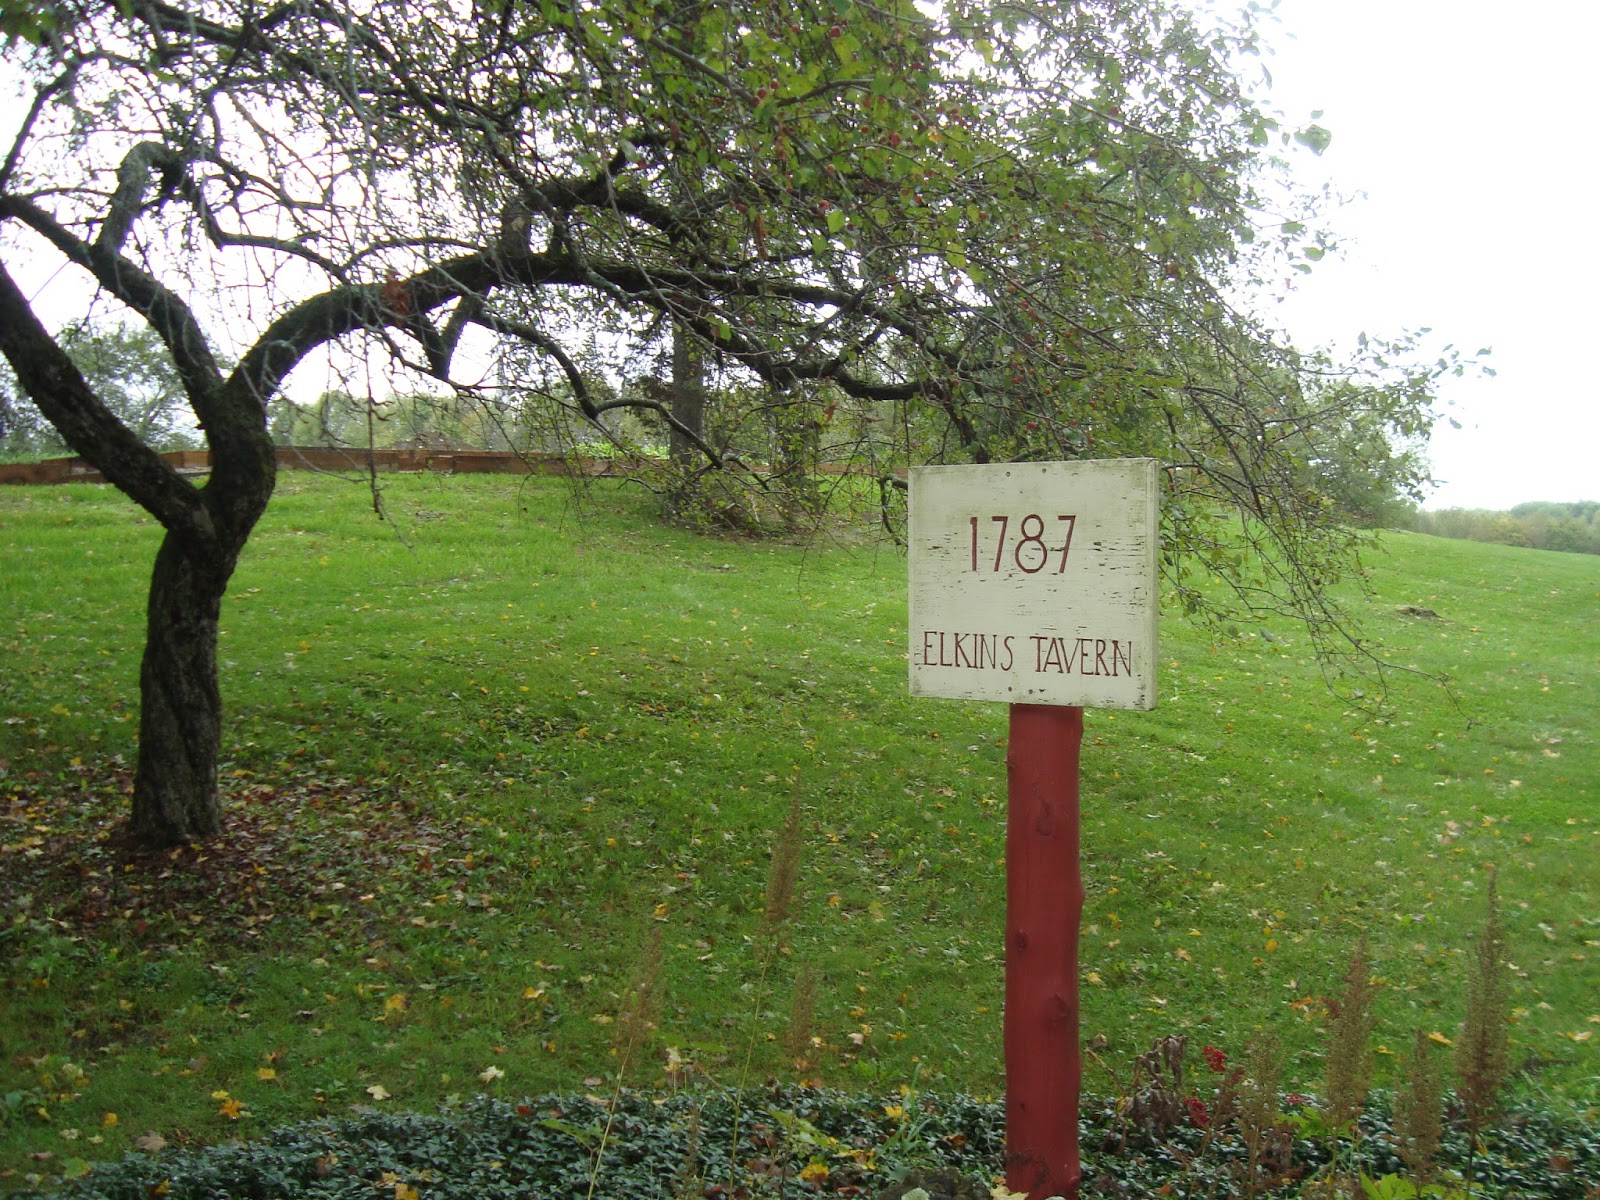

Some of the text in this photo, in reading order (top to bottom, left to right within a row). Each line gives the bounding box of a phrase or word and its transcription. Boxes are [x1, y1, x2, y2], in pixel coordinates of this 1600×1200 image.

[970, 513, 1077, 574] 1787
[923, 631, 1132, 677] ELKINS TAVERN
